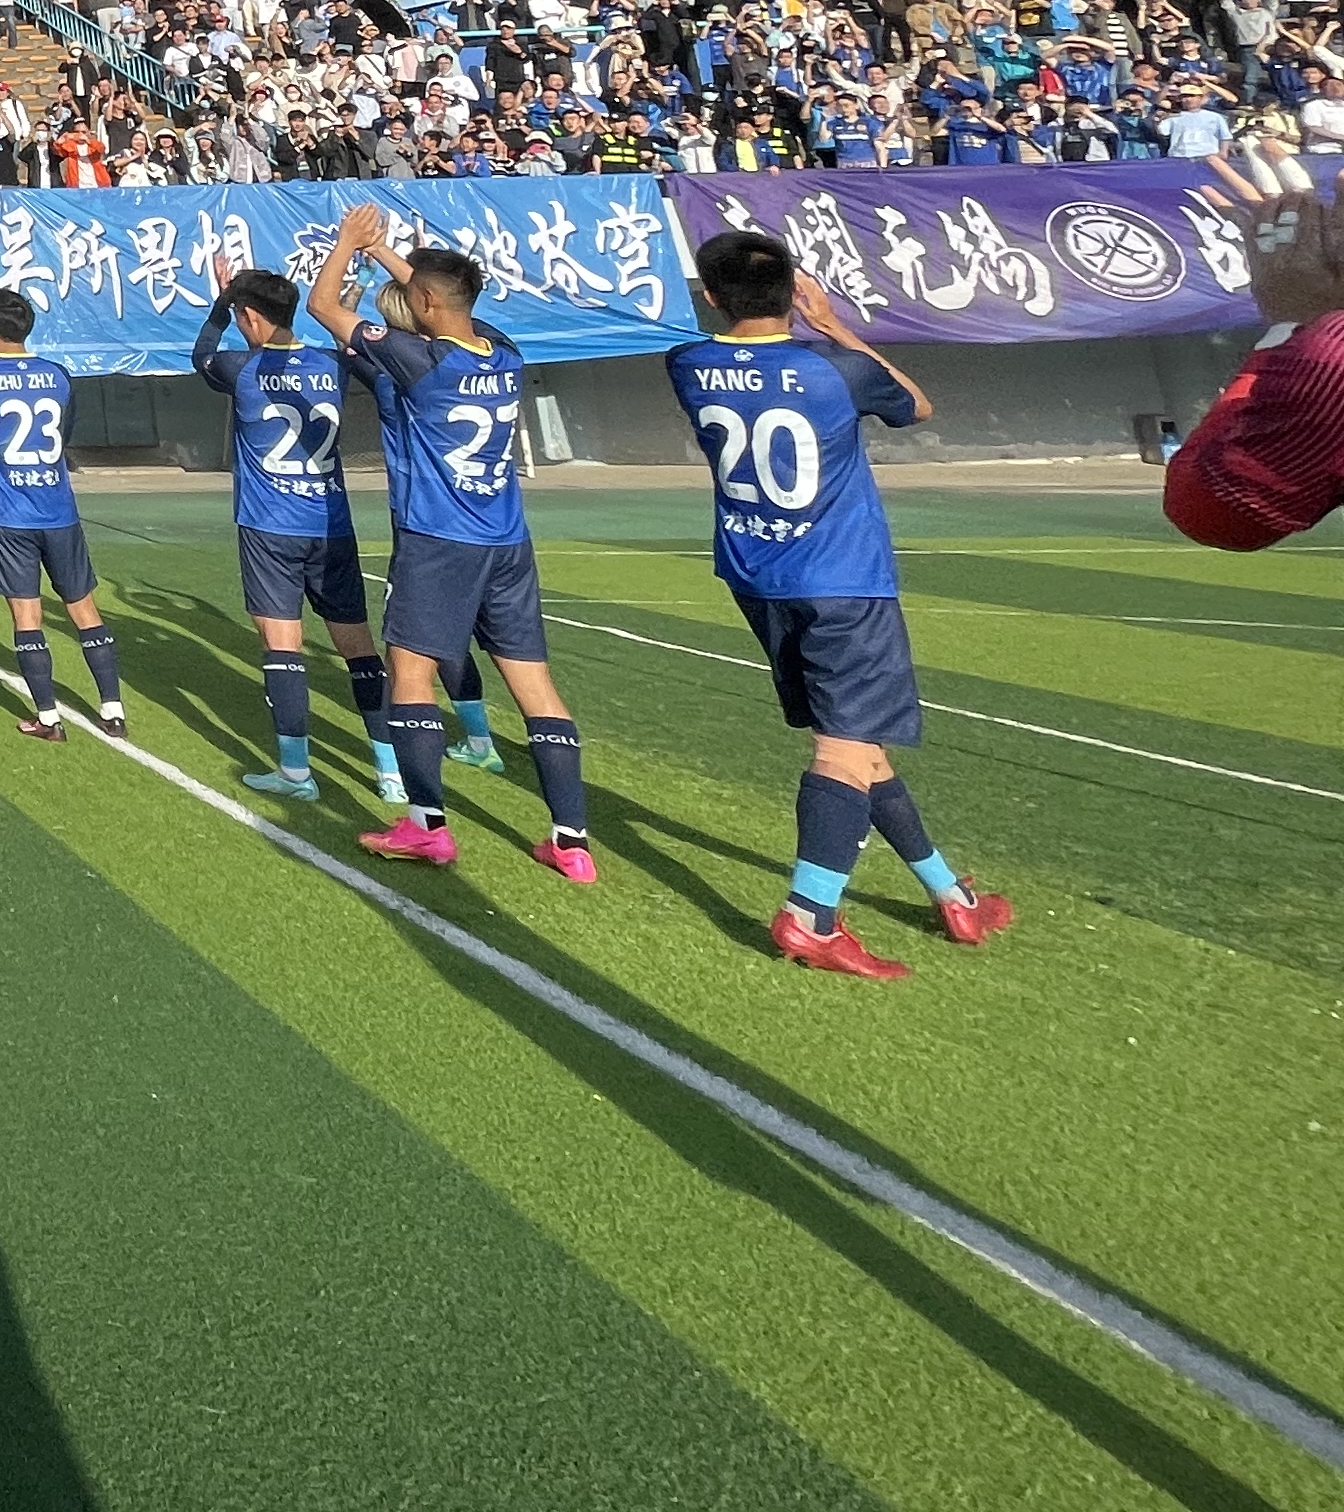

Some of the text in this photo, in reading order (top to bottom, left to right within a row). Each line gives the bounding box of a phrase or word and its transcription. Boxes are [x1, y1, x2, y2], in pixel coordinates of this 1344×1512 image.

[715, 191, 1055, 324] 耀无锡
[258, 373, 339, 392] KONG Y.Q.
[458, 374, 500, 396] LIAN
[694, 368, 805, 393] YANG F.
[0, 397, 63, 466] 23
[262, 401, 340, 476] 22
[443, 399, 520, 477] 27
[698, 404, 819, 510] 20
